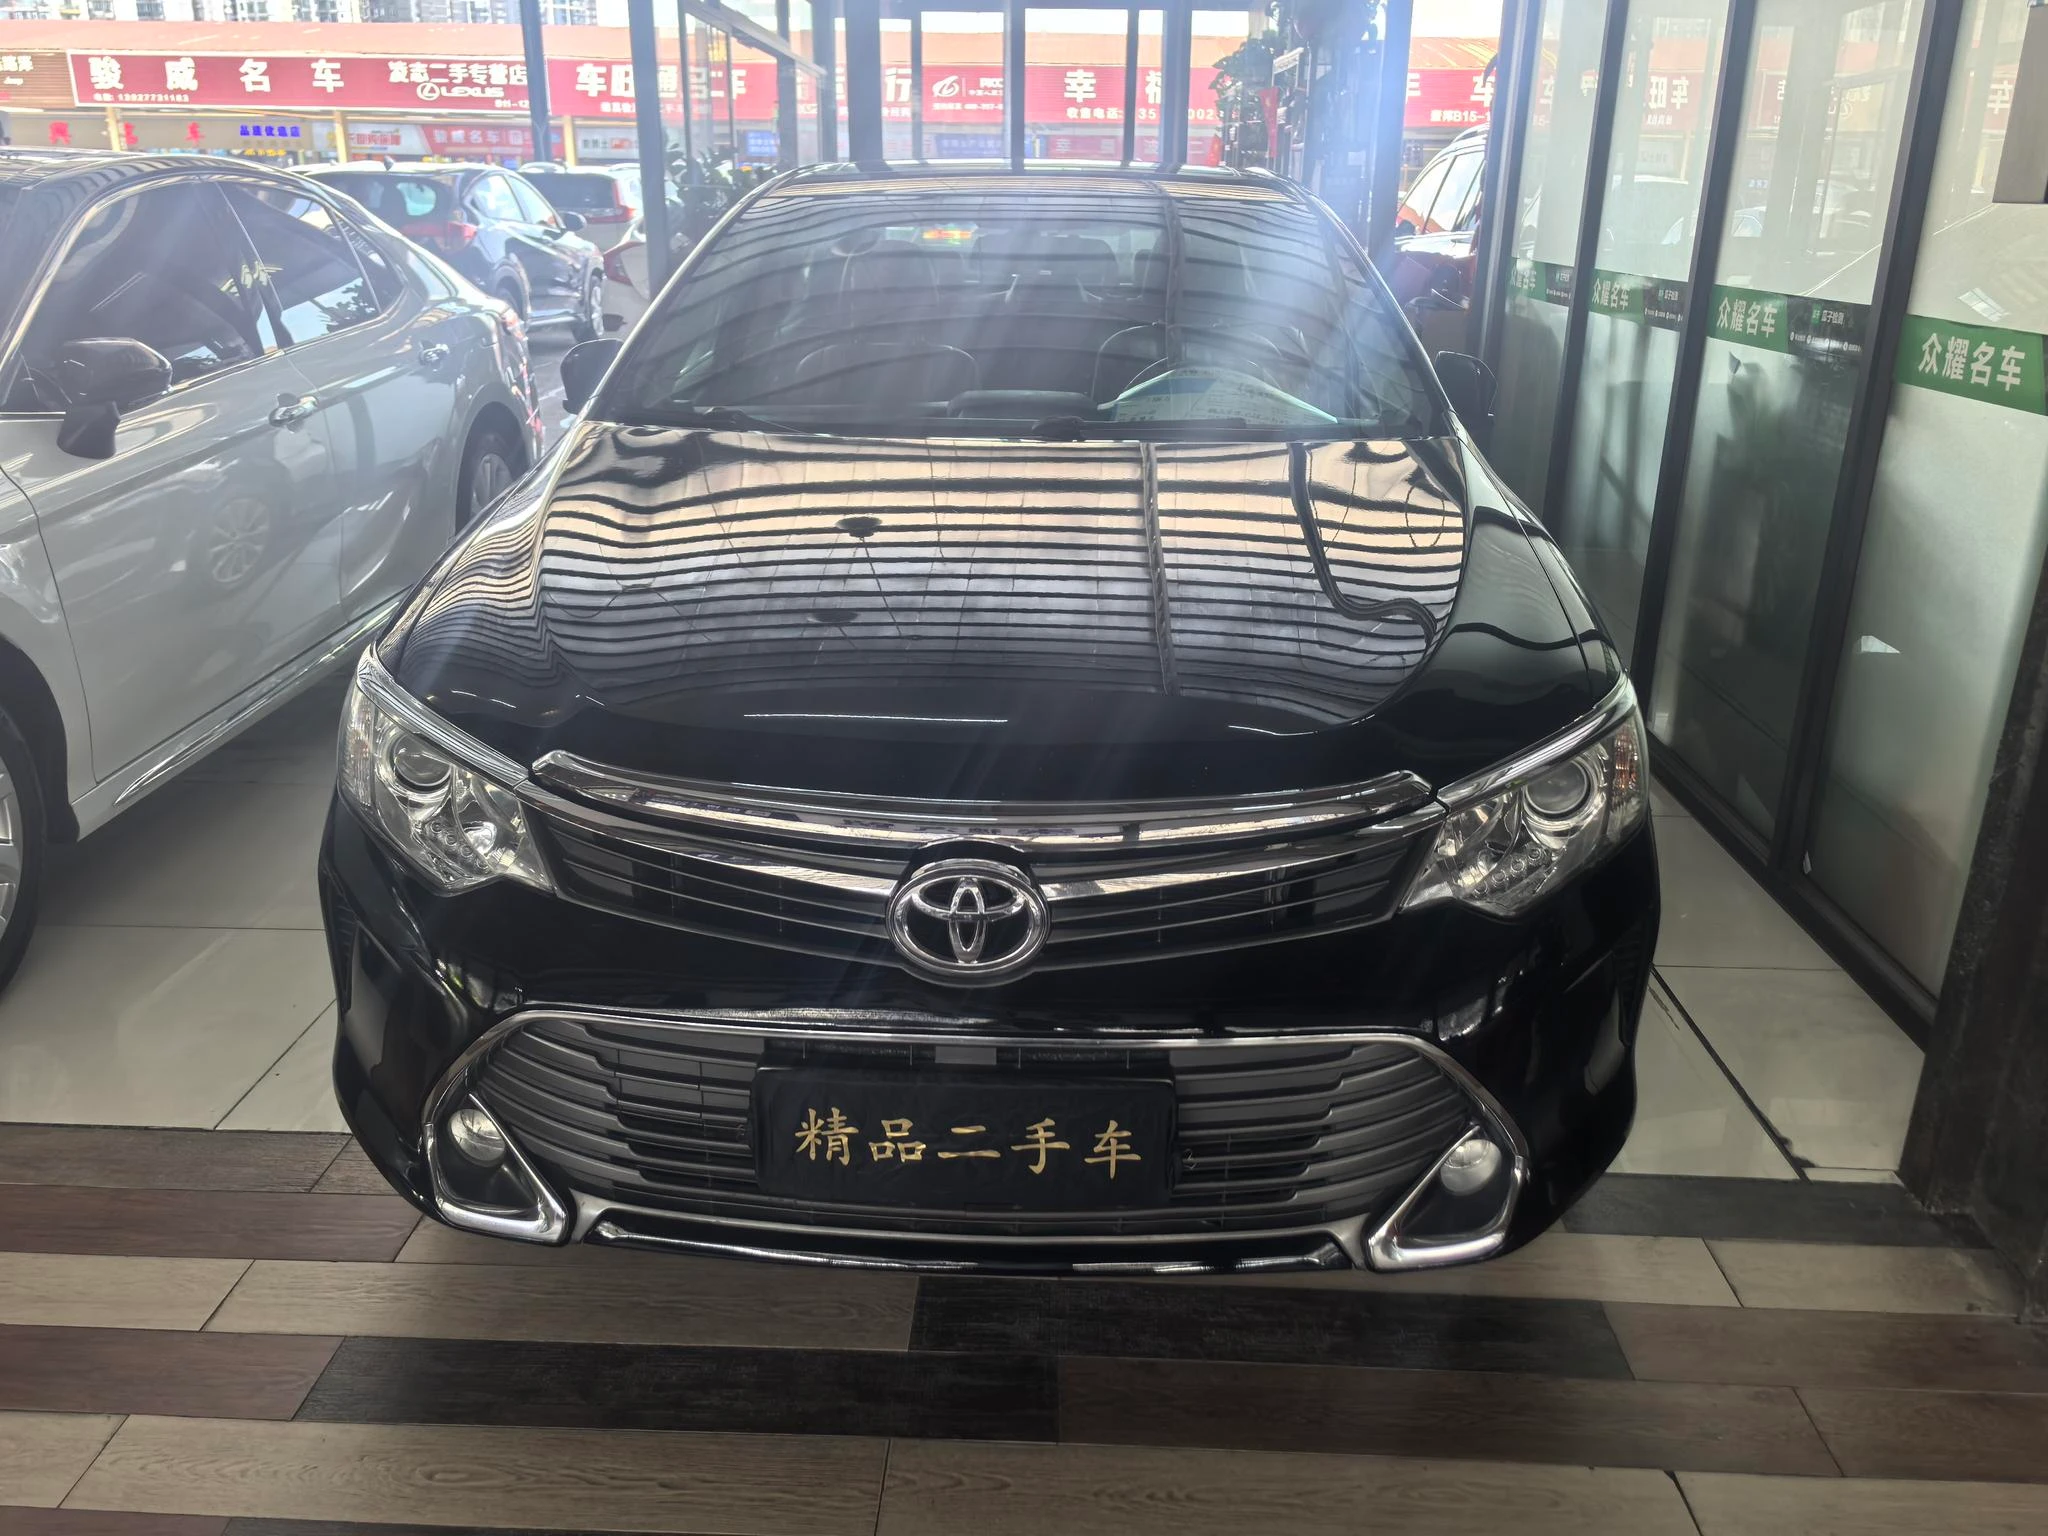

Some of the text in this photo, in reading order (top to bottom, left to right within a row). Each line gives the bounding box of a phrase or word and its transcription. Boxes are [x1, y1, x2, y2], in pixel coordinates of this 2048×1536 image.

[88, 56, 344, 93] 骏威名车
[440, 86, 504, 98] LEXUS
[1716, 296, 1778, 339] 众耀名车
[1918, 332, 2026, 392] 众耀名车
[795, 1106, 1143, 1180] 精品二手车
